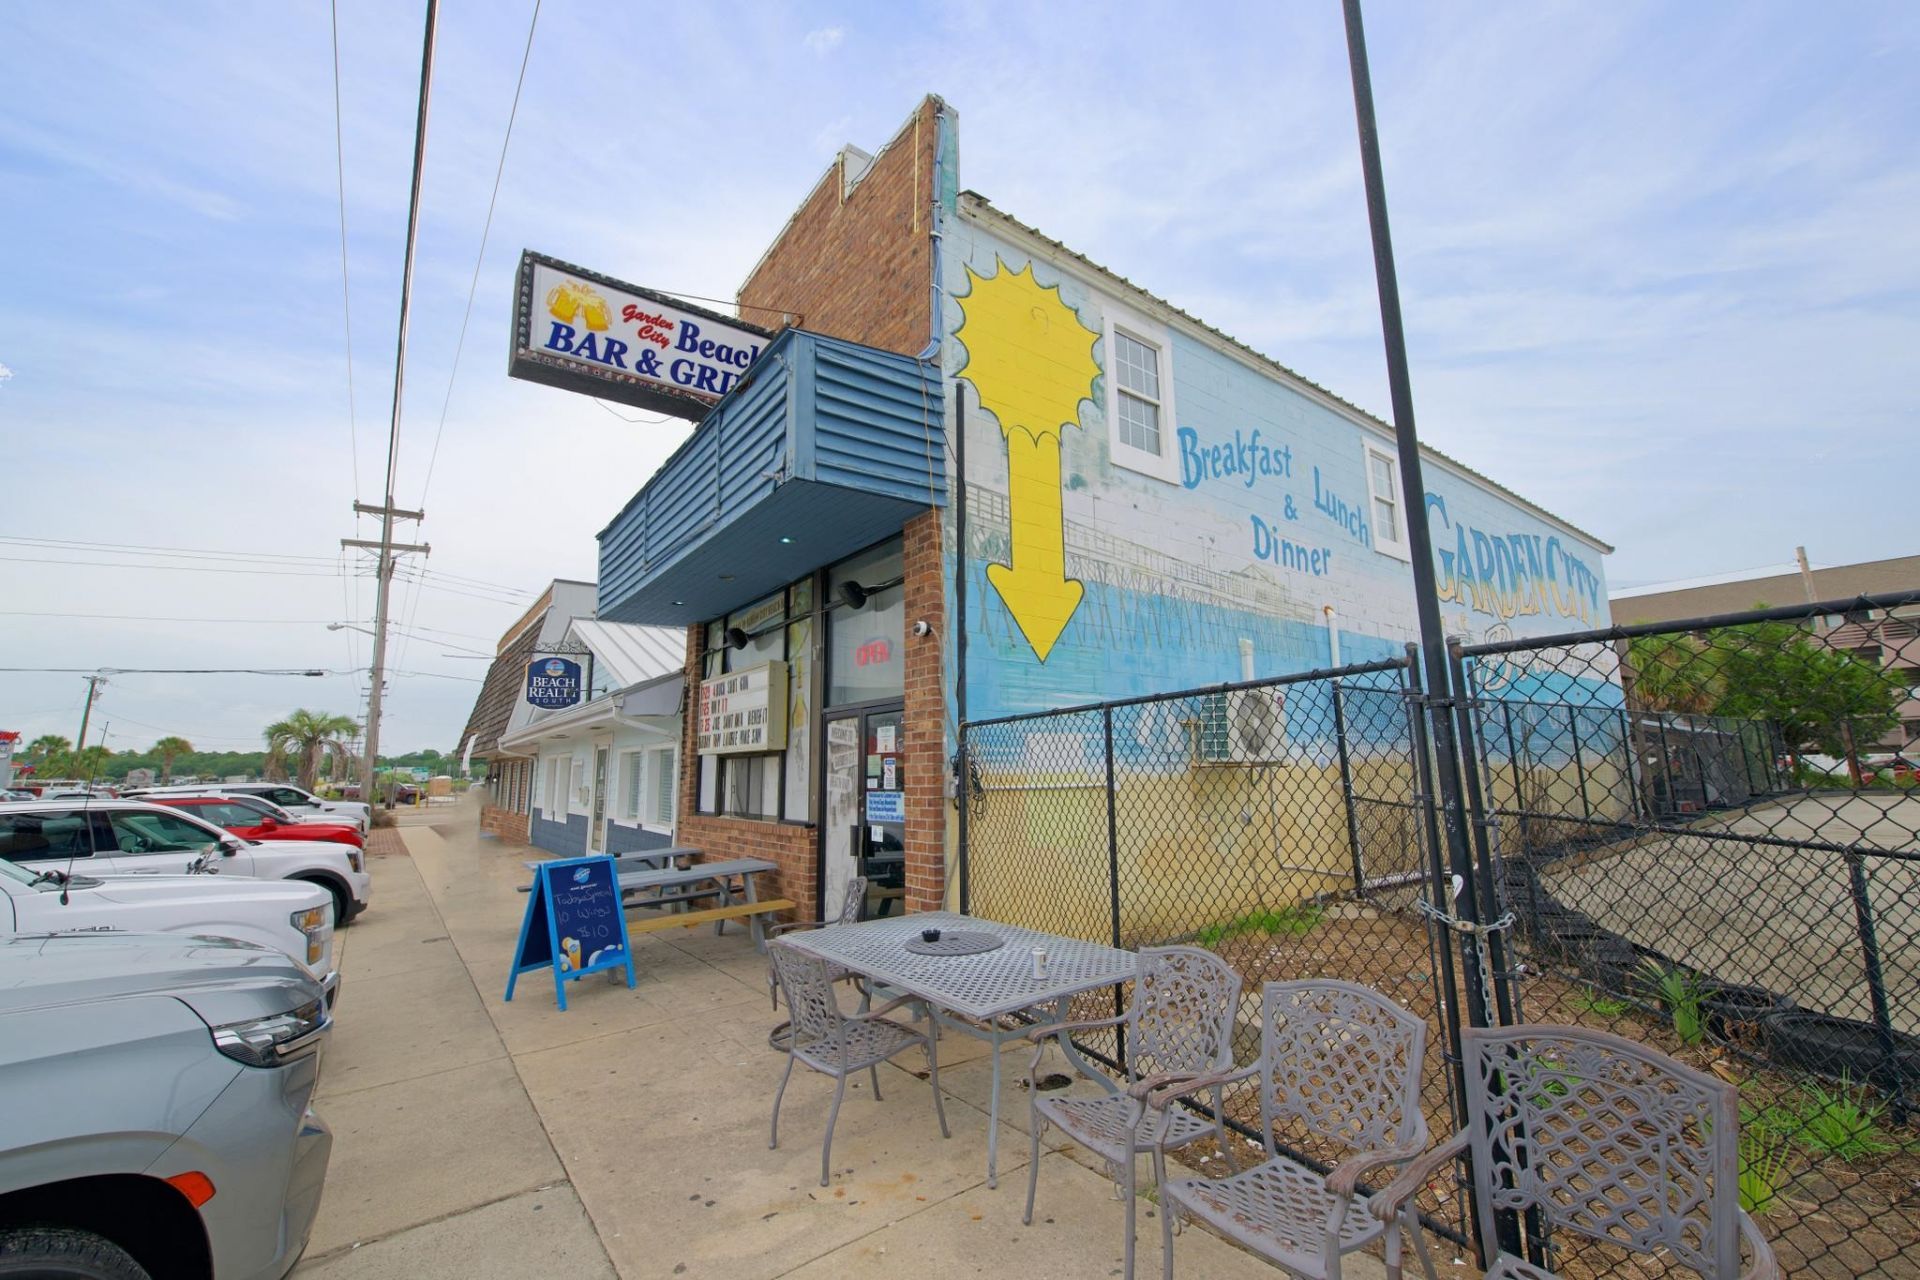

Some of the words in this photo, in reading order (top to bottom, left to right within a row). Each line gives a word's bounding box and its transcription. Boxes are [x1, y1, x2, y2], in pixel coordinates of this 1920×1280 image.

[622, 303, 674, 331] Garden
[637, 325, 670, 349] City
[544, 321, 628, 370] BAR
[635, 348, 664, 378] &
[670, 358, 741, 395] GRI
[1177, 426, 1292, 490] Breakfast
[1284, 493, 1298, 520] &
[1314, 465, 1370, 549] Lunch
[1251, 513, 1331, 576] Dinner
[1424, 492, 1541, 623] GARDEN
[1545, 535, 1600, 630] CITY
[856, 641, 889, 667] OPEN
[533, 677, 576, 688] BEACH
